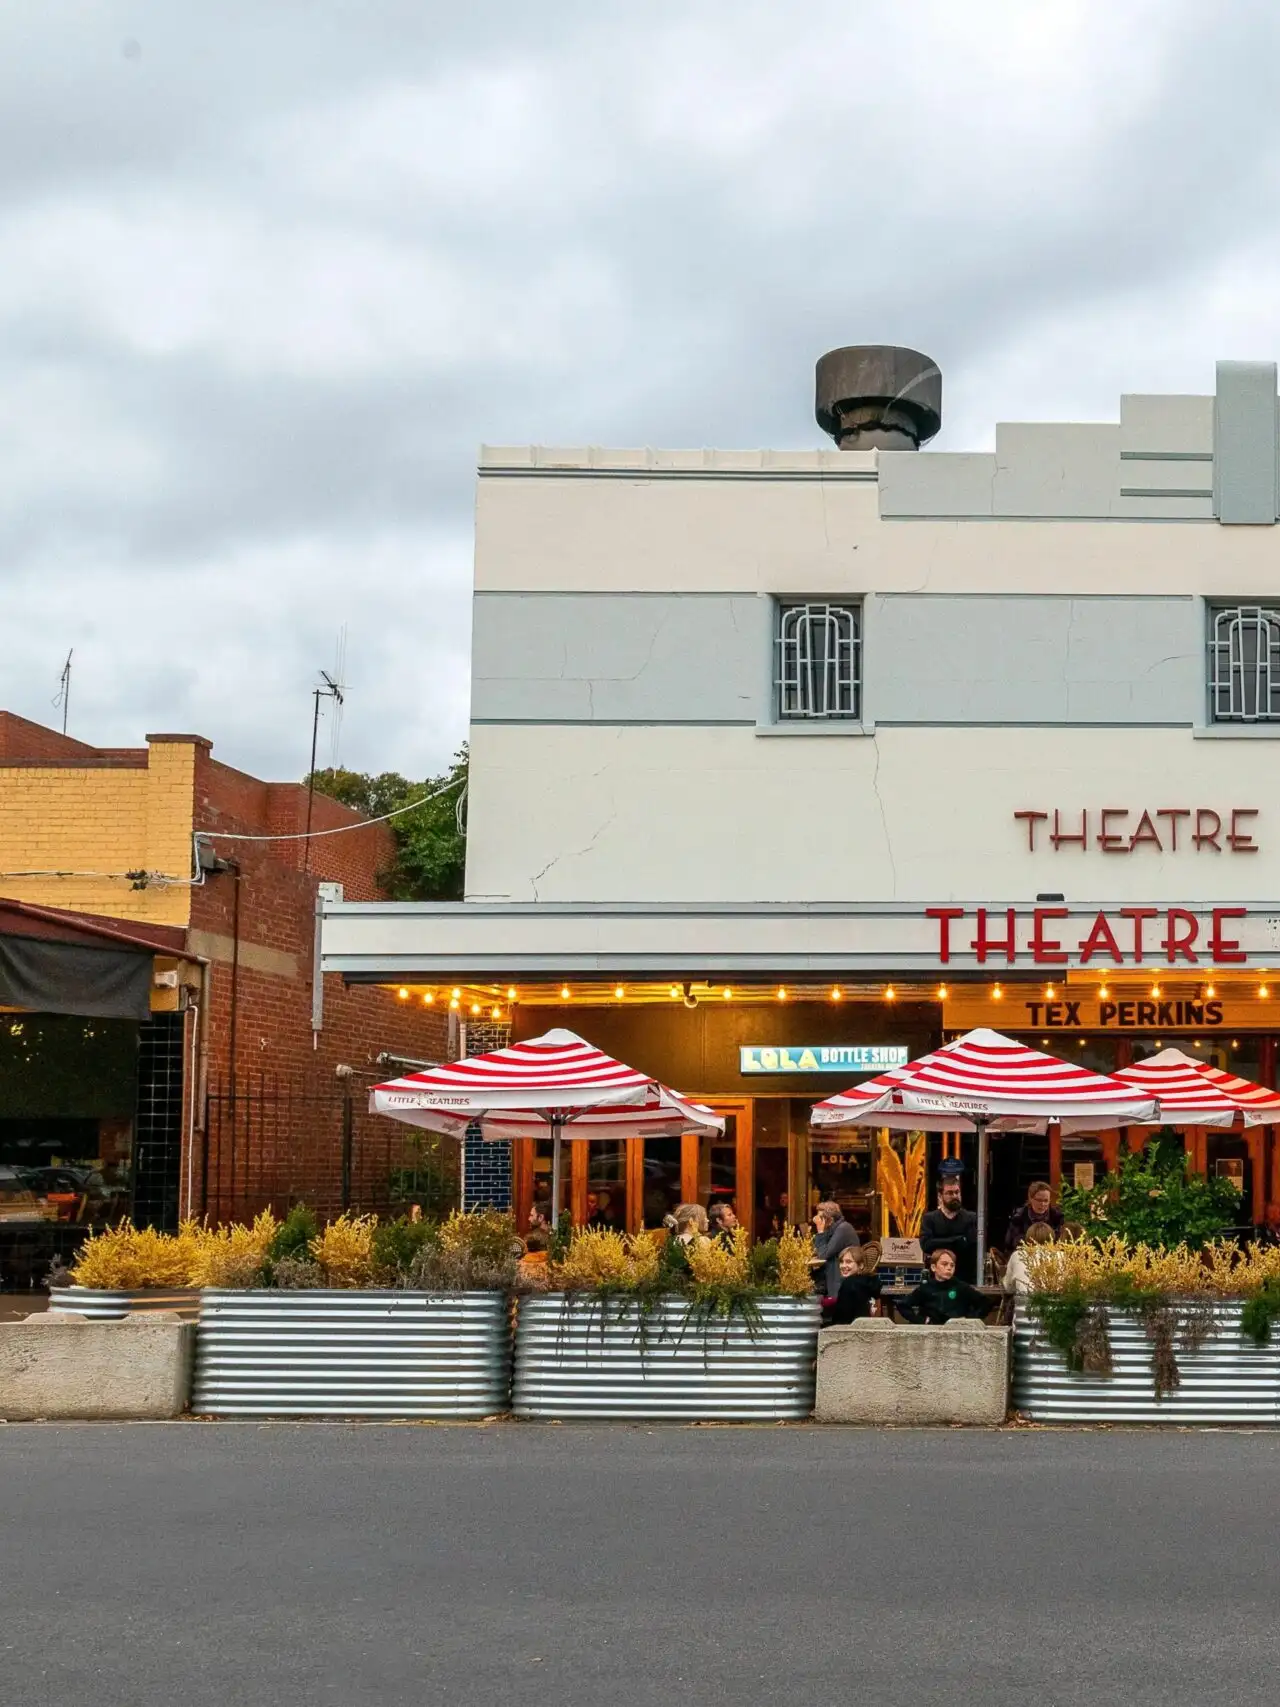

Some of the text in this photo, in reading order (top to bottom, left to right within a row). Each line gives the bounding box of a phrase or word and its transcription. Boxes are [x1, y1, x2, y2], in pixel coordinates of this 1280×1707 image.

[1014, 808, 1259, 852] THEATRE
[925, 907, 1247, 963] THEATRE
[1026, 1001, 1082, 1027] TEX
[1101, 1001, 1223, 1027] PERKINS
[744, 1049, 906, 1070] LOLA BOTTLE SHOP
[417, 1096, 470, 1106] REATURES
[821, 1155, 858, 1164] LOLA
